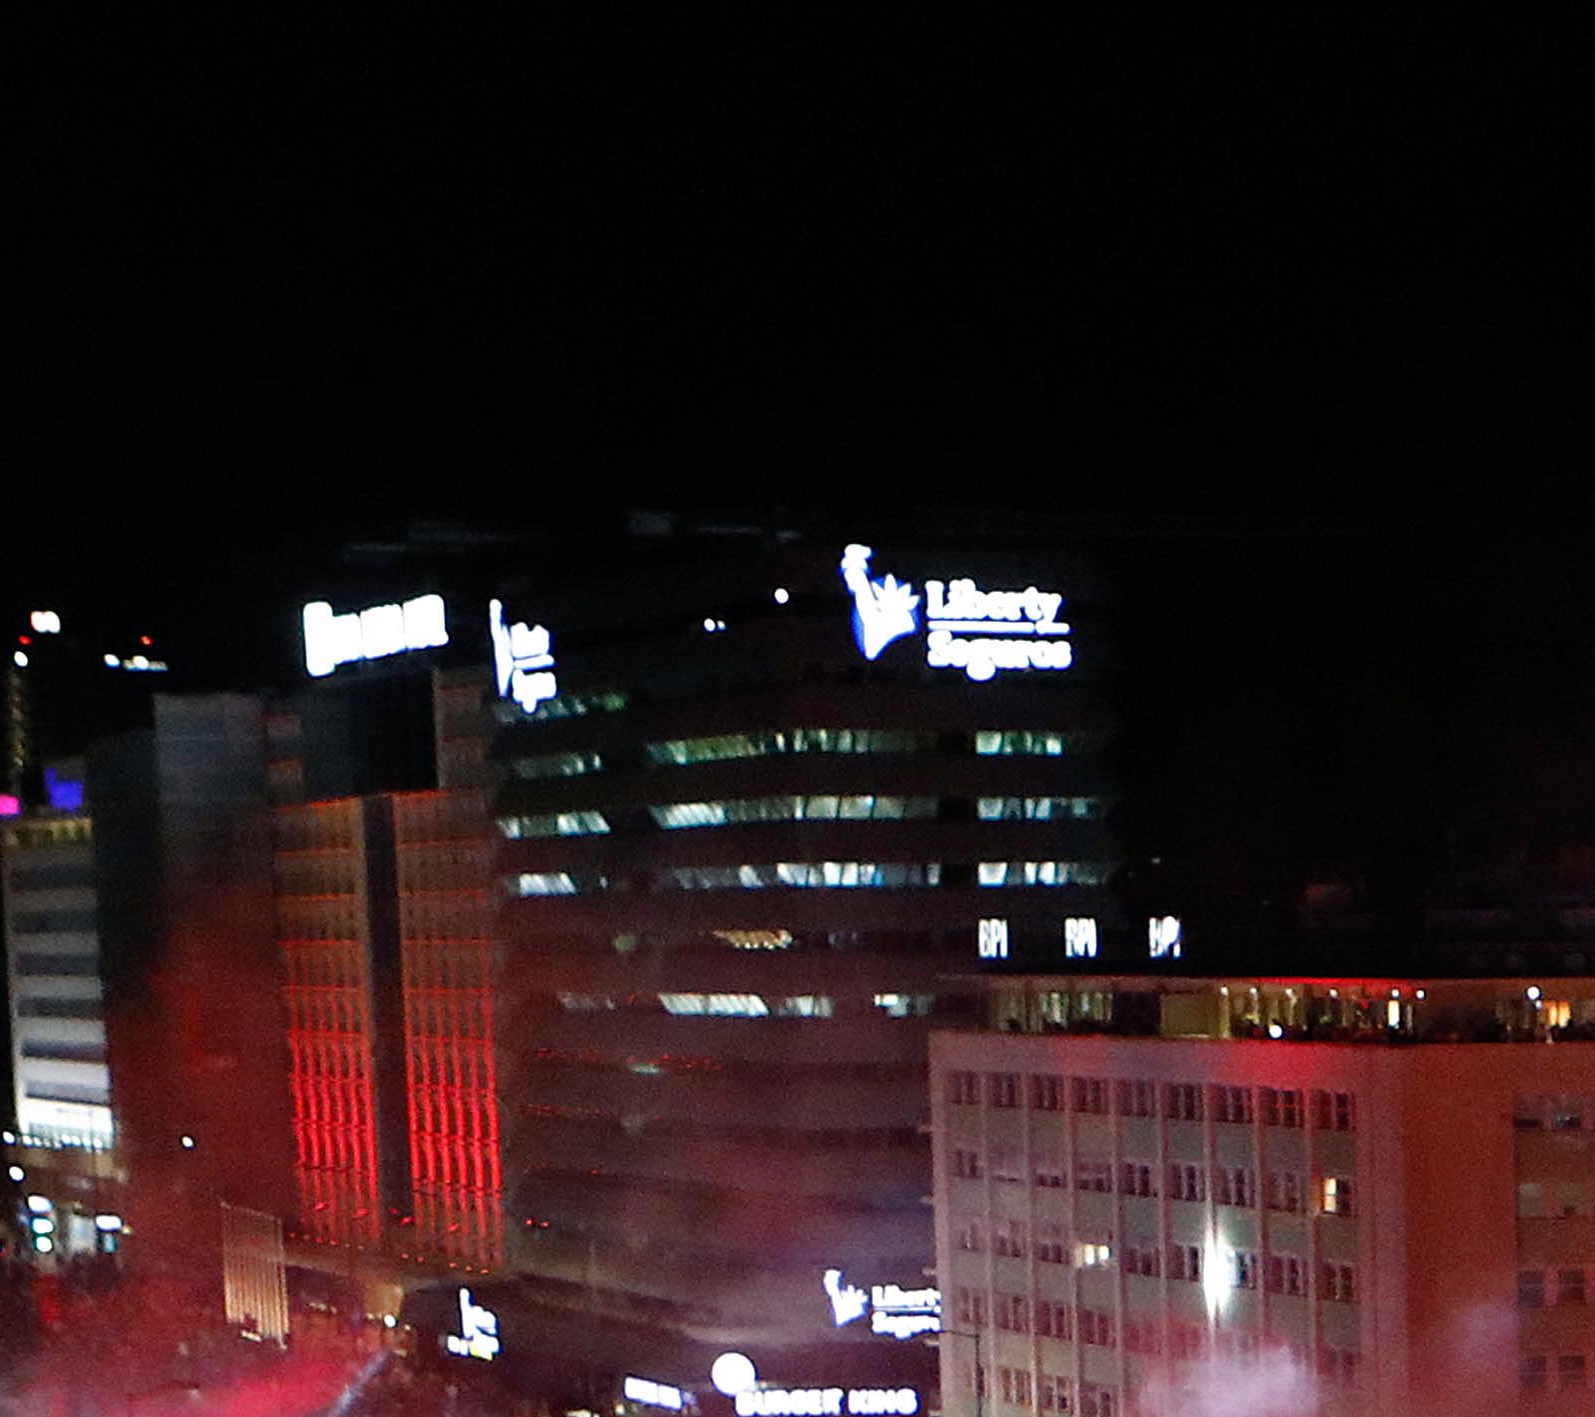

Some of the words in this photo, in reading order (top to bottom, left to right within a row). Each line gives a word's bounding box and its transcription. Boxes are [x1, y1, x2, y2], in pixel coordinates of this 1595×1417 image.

[925, 578, 1062, 622] Liberty
[927, 630, 1072, 680] Seguros
[978, 918, 1008, 958] BPI
